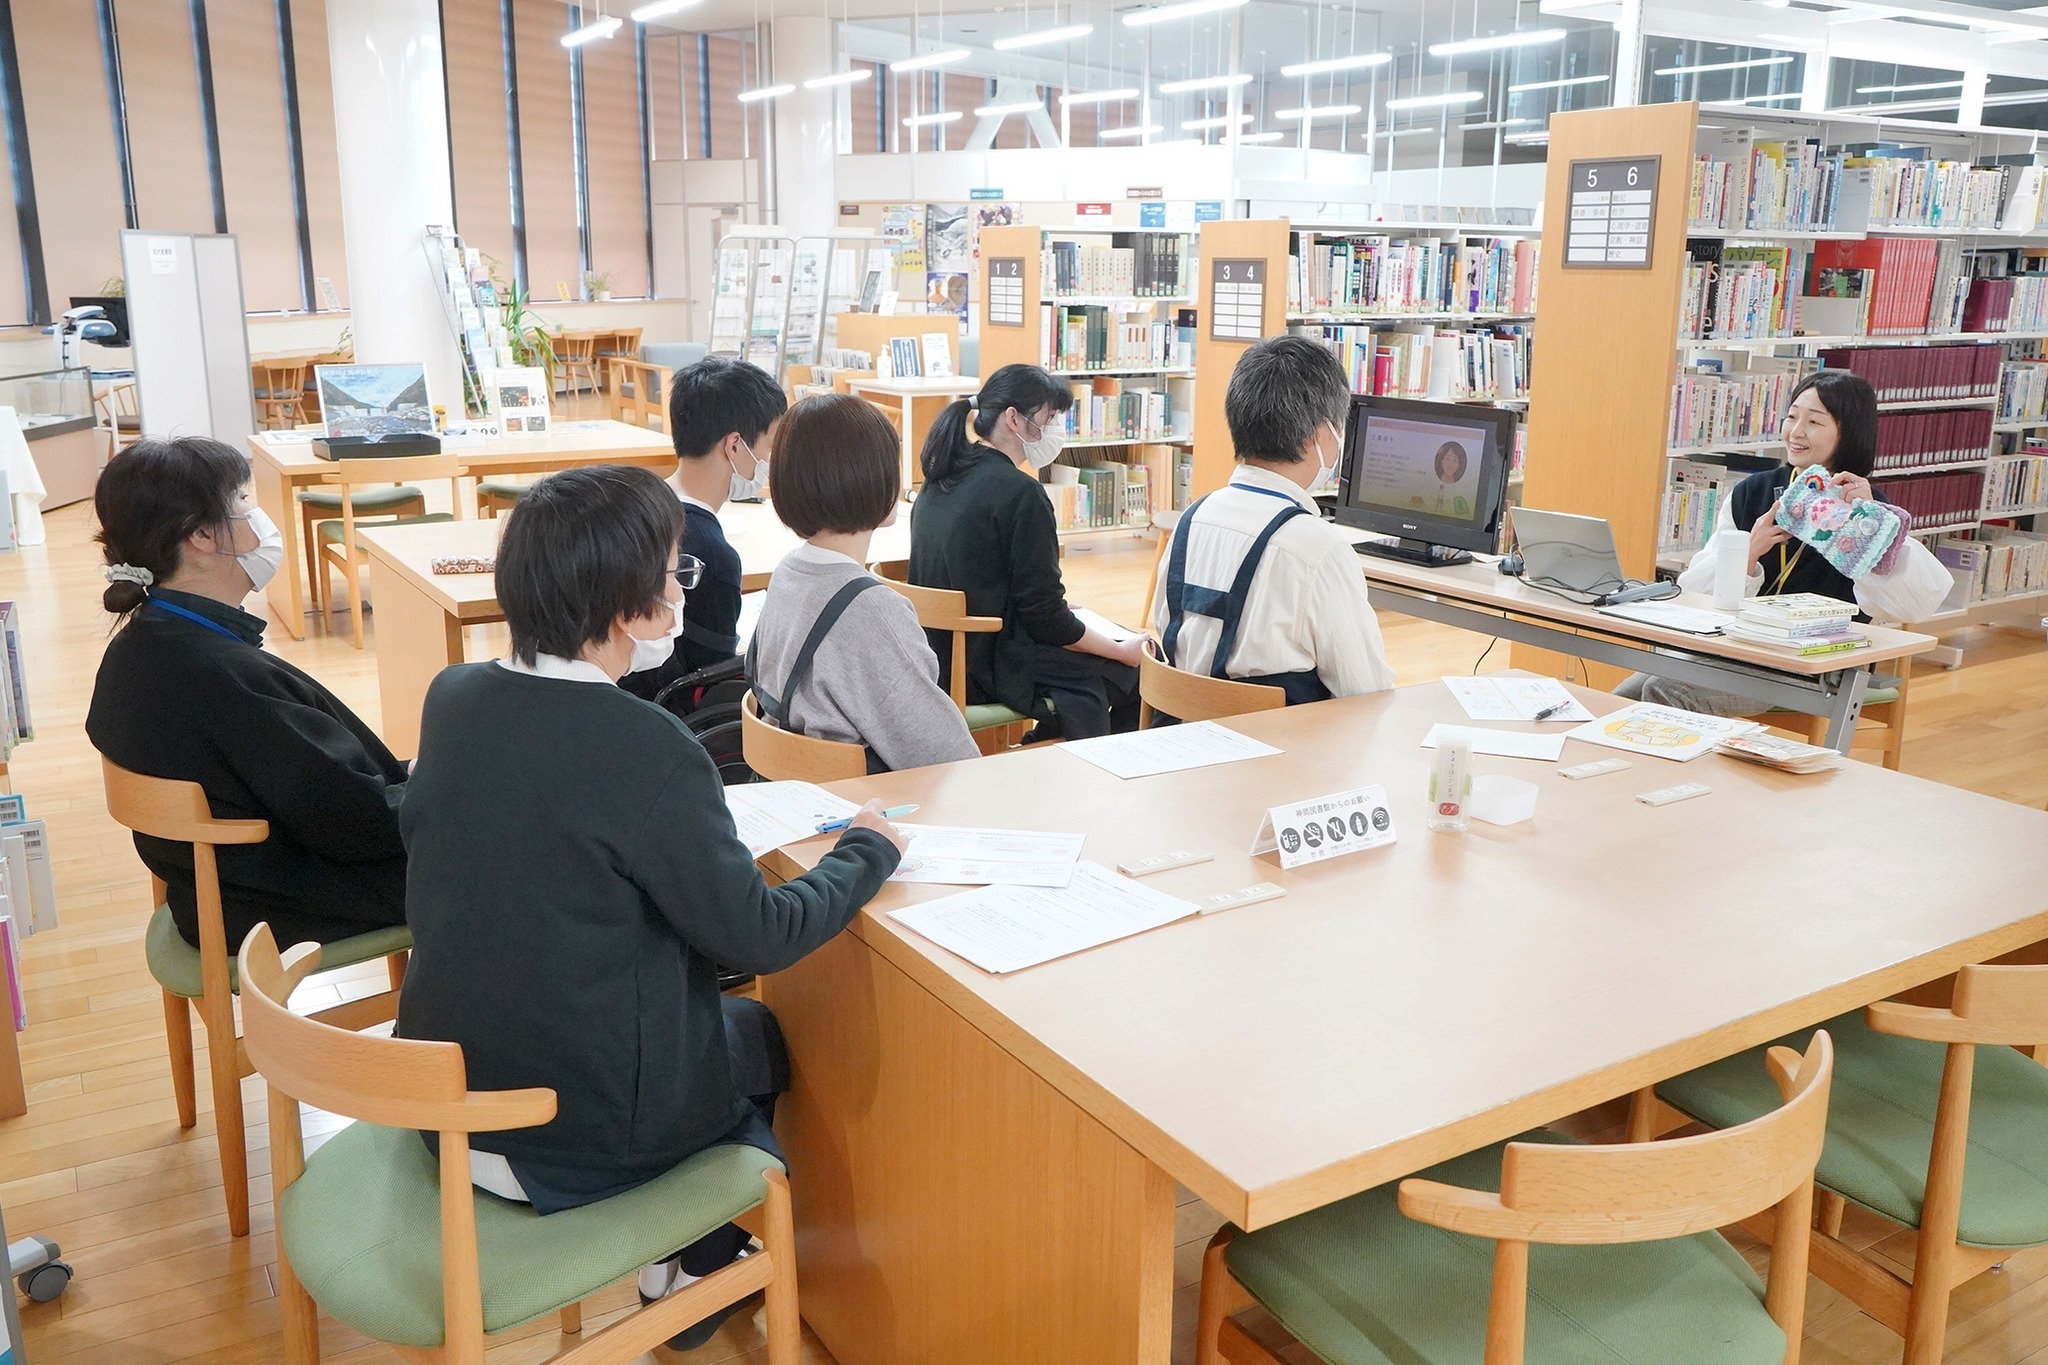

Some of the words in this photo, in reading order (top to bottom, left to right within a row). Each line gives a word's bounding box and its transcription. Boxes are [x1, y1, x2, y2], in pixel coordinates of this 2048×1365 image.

[1587, 169, 1598, 188] 5
[1627, 166, 1638, 186] 6
[995, 263, 1000, 275] 1
[1011, 263, 1017, 275] 2
[1223, 265, 1230, 280] 3
[1246, 265, 1254, 280] 4
[1402, 523, 1417, 531] SONY
